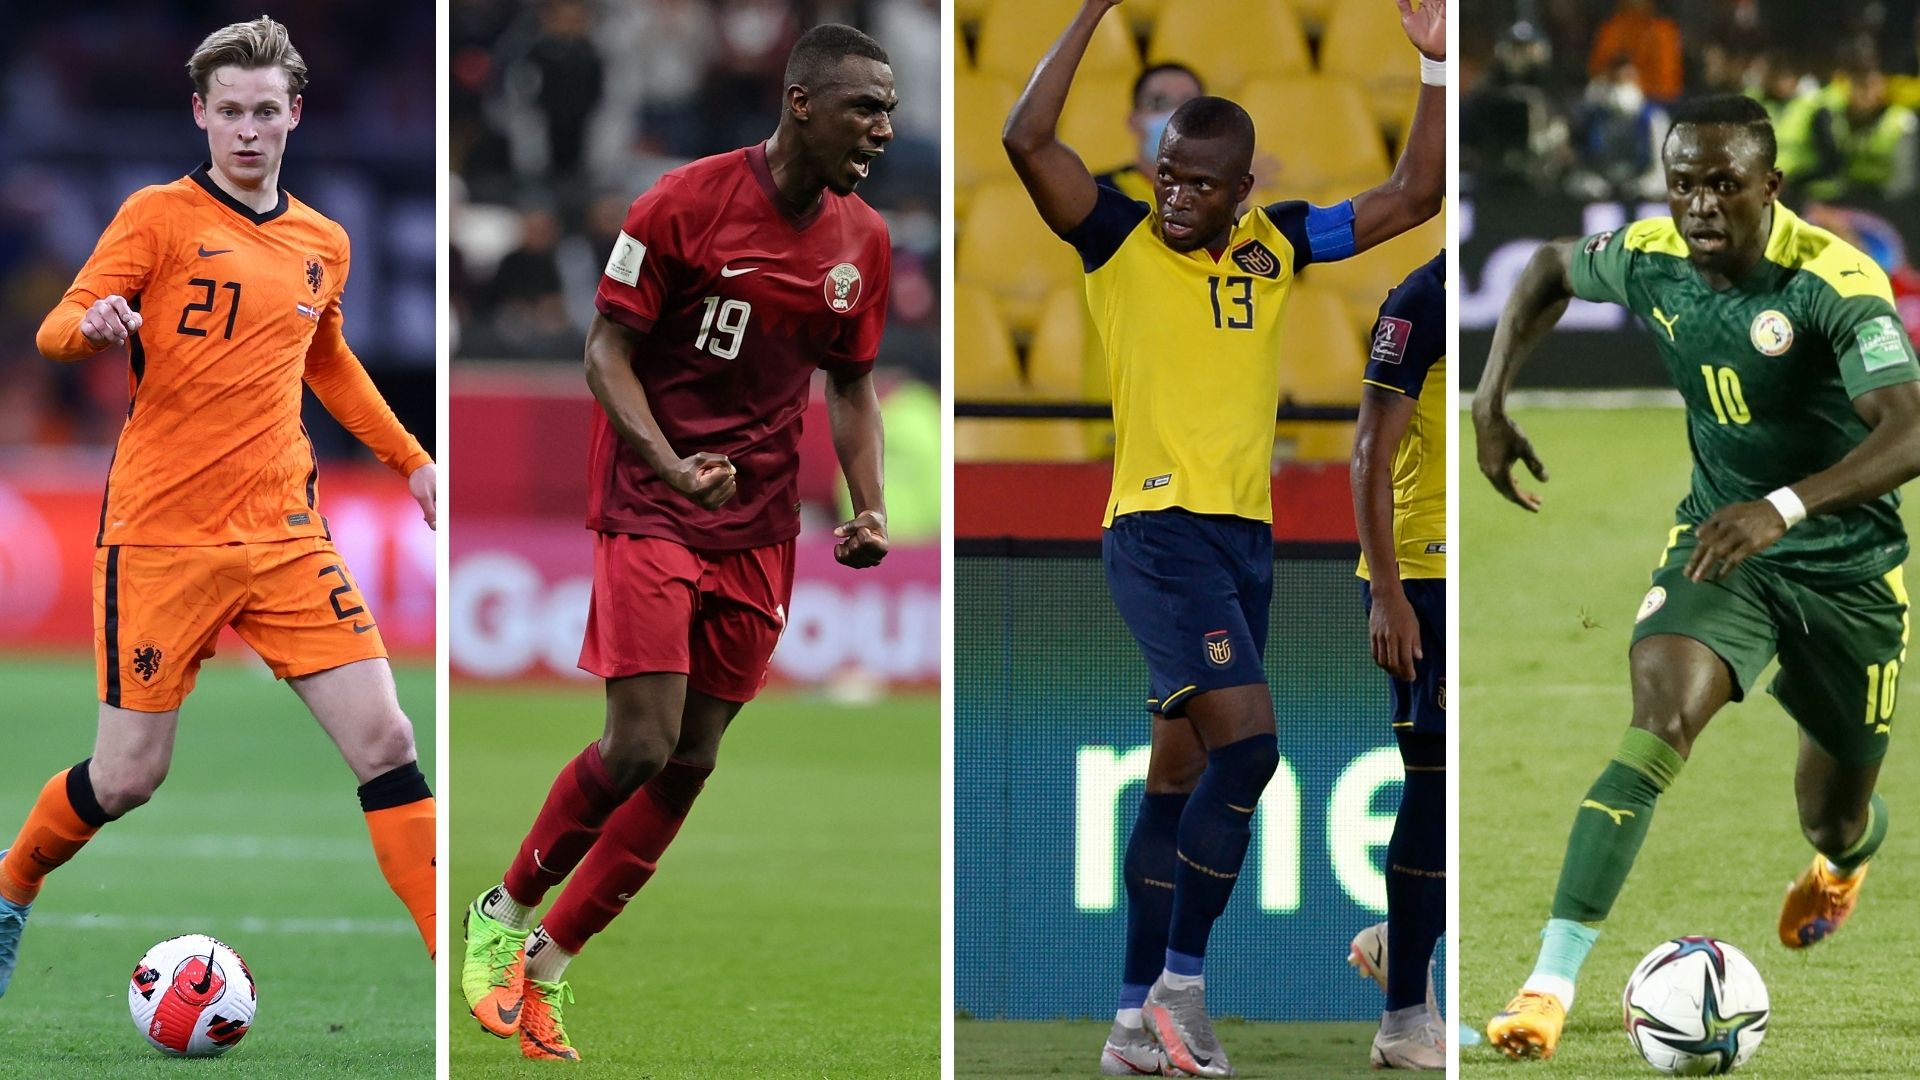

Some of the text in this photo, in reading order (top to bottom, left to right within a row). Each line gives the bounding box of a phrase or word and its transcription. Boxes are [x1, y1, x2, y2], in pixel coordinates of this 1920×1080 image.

[176, 278, 242, 340] 21
[694, 295, 752, 361] 19
[1207, 275, 1254, 330] 13
[1700, 364, 1752, 425] 10
[317, 564, 365, 621] 2
[1864, 658, 1899, 725] 10
